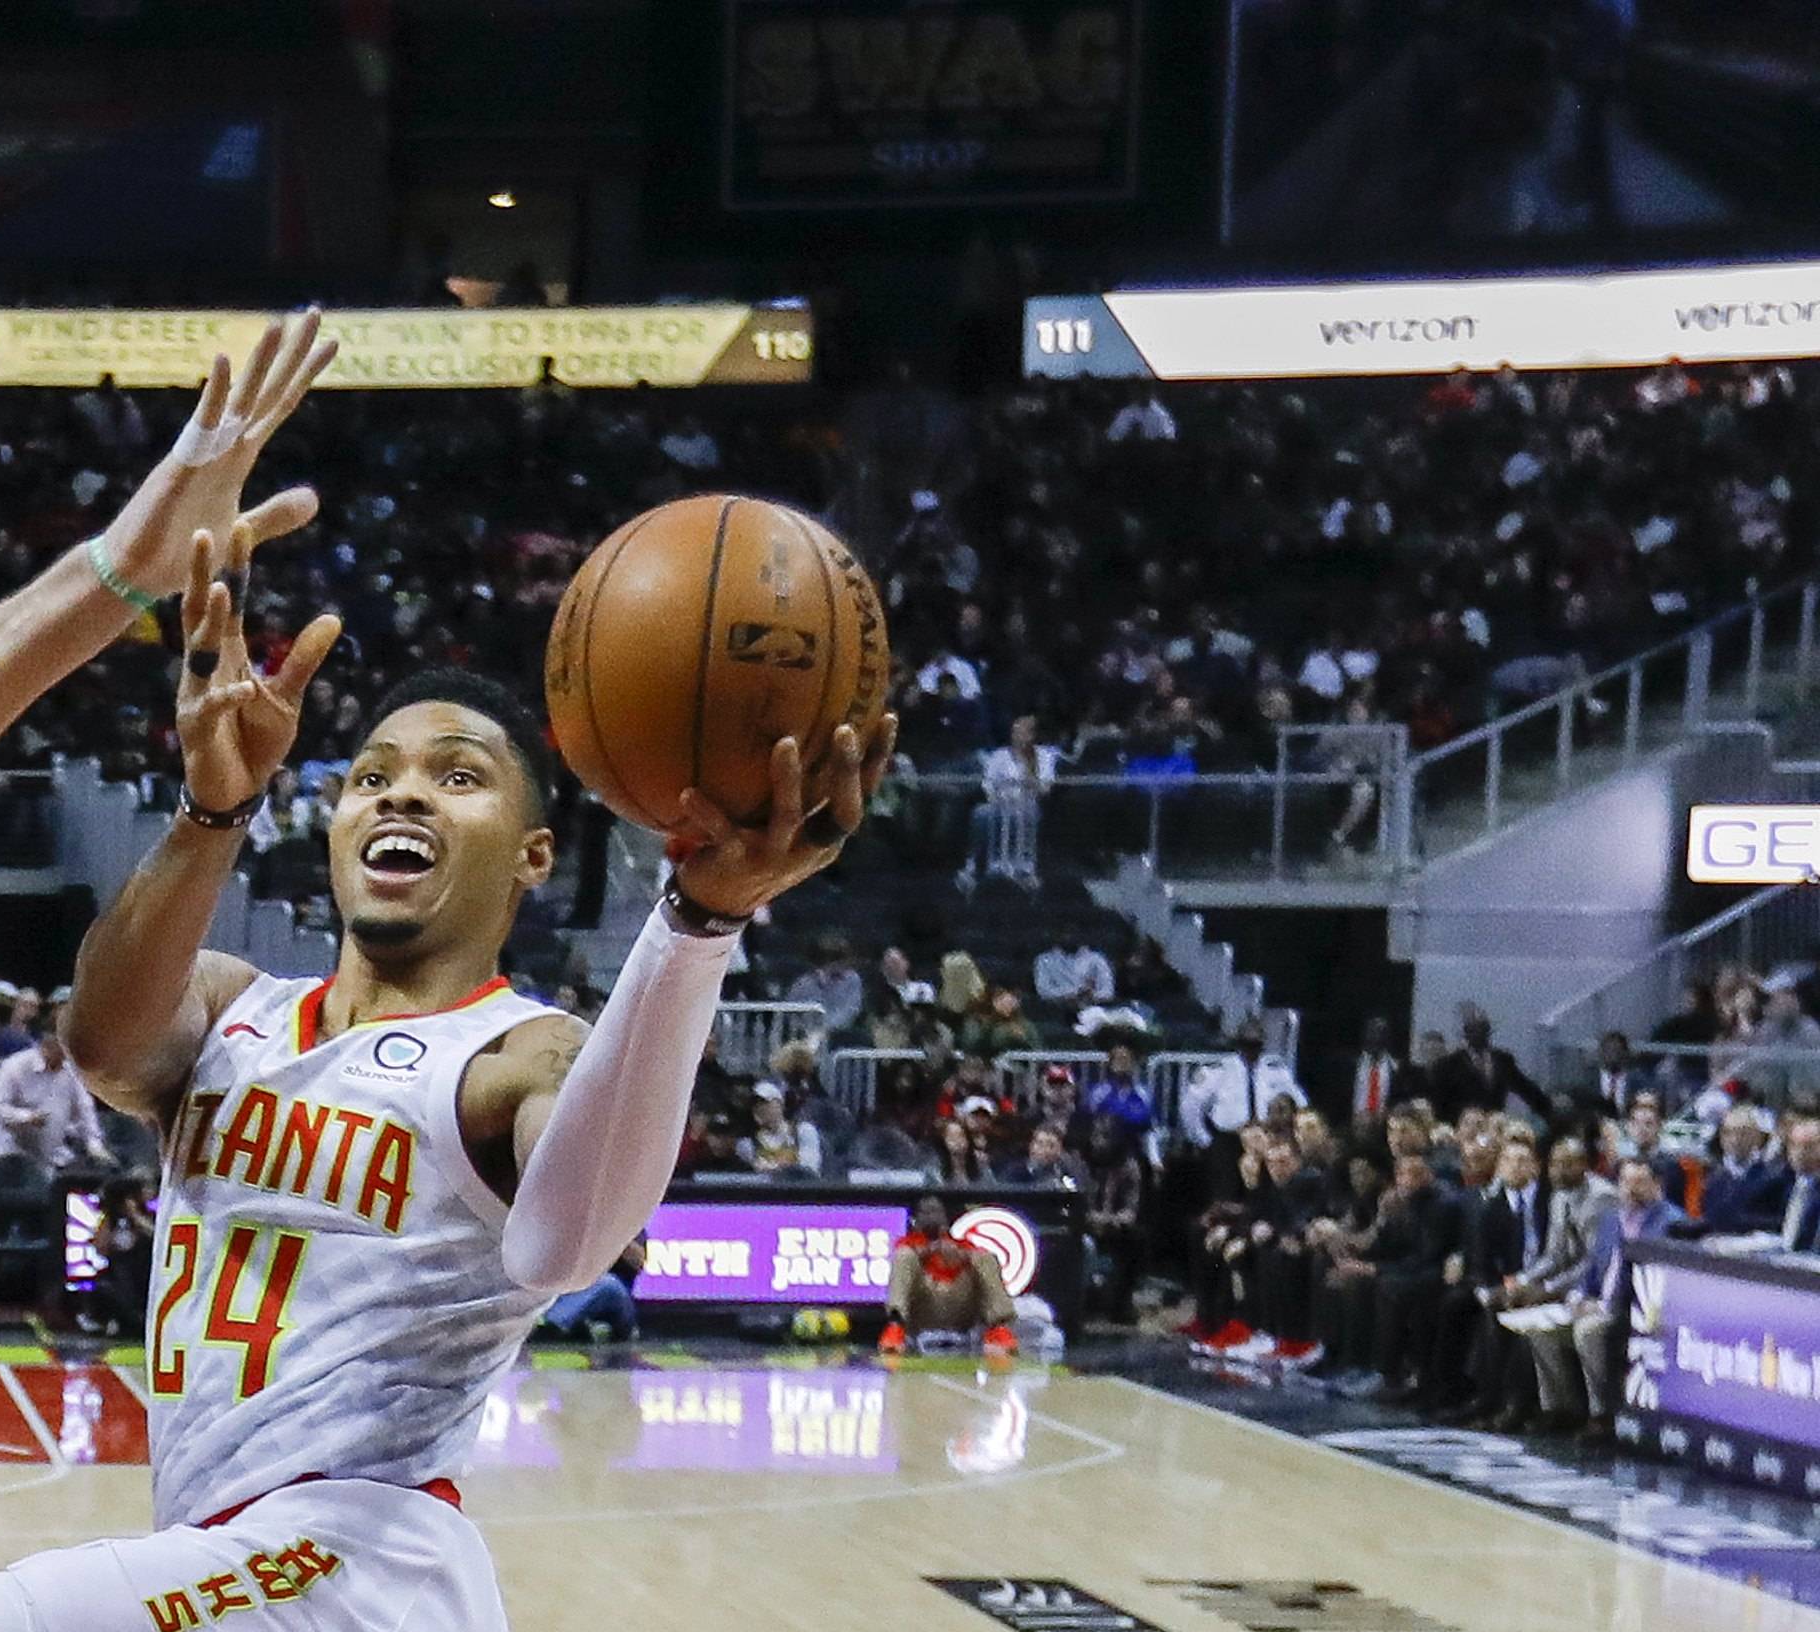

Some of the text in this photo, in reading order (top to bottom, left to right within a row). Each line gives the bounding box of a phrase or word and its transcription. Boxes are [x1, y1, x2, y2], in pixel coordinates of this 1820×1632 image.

[1318, 313, 1479, 346] verizon
[777, 1227, 890, 1258] ENDS
[771, 1254, 841, 1291] JAN
[151, 1215, 313, 1405] 24
